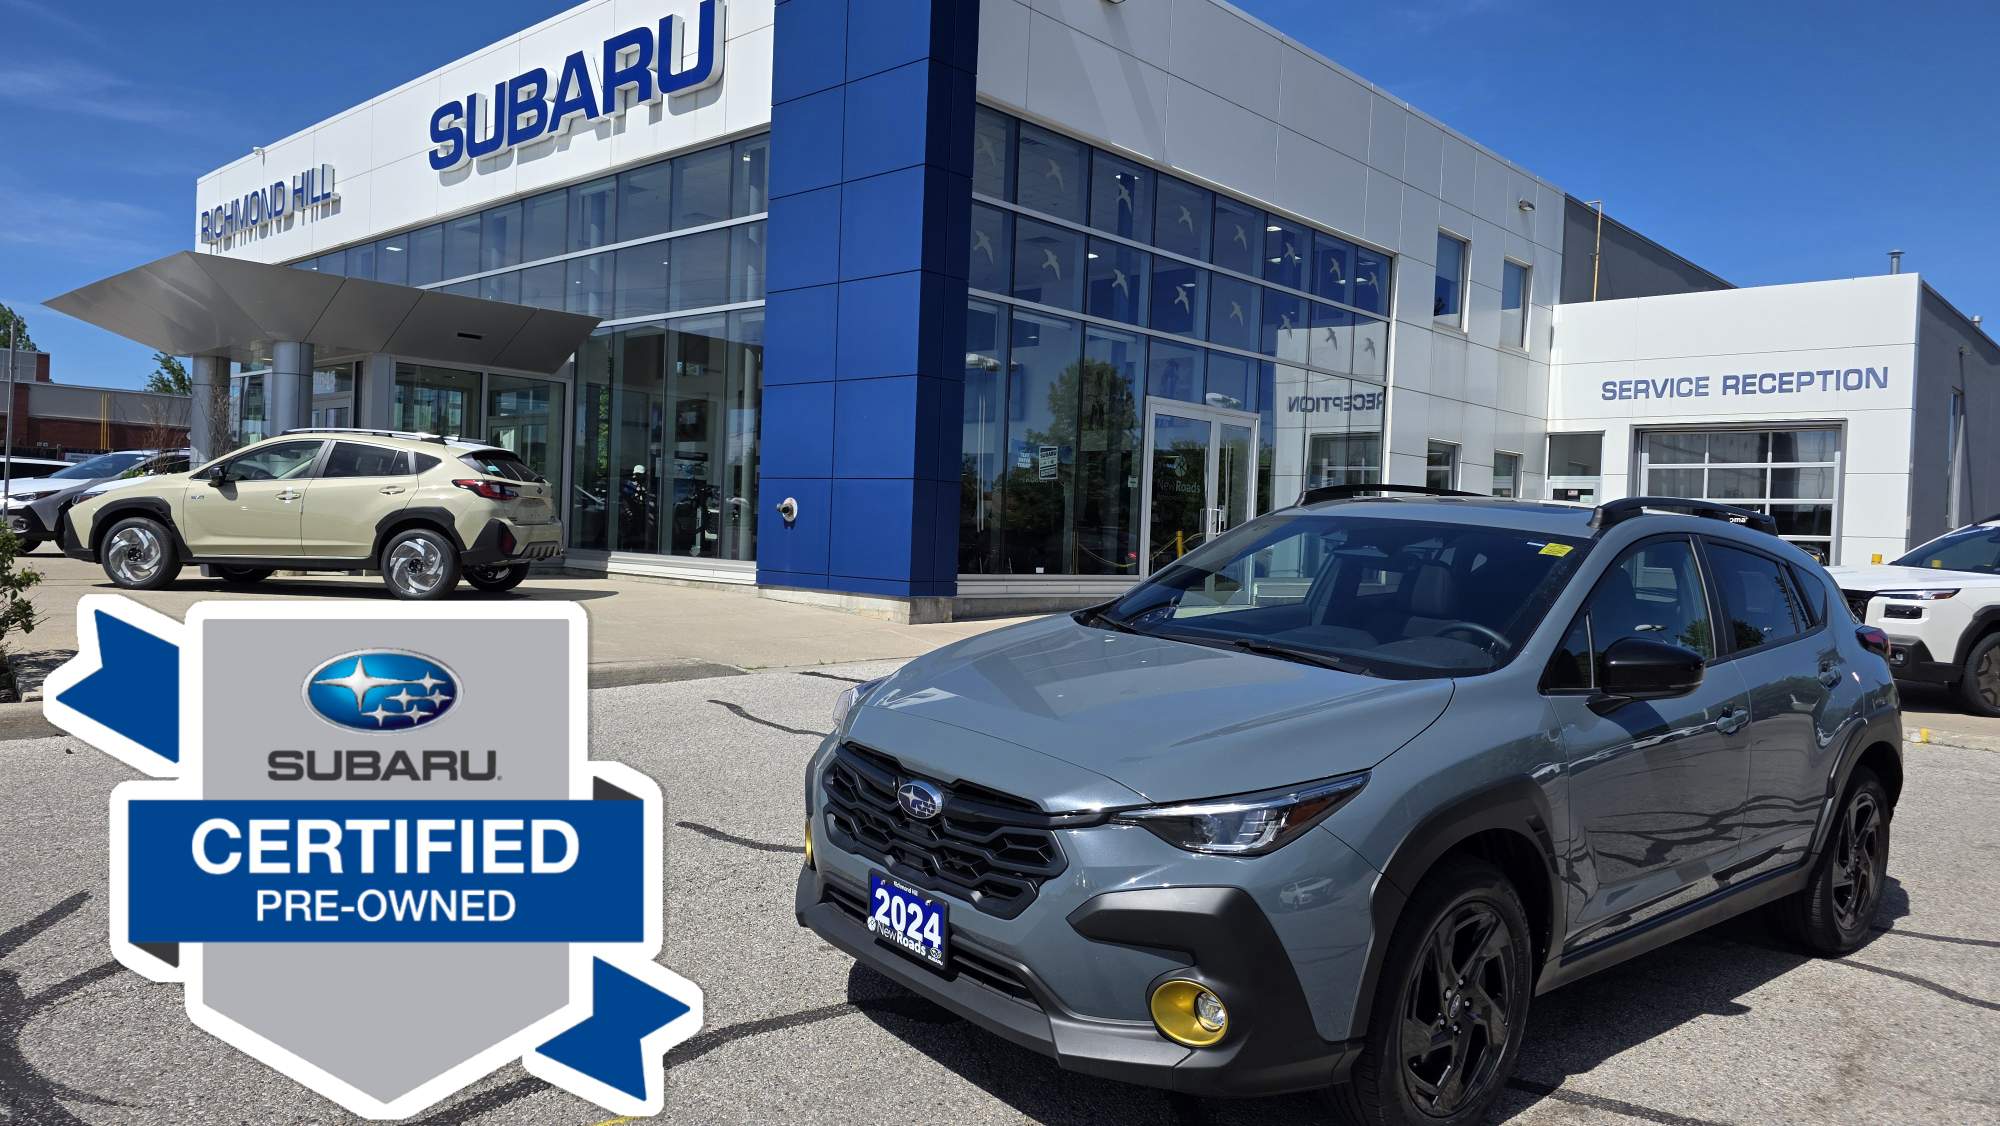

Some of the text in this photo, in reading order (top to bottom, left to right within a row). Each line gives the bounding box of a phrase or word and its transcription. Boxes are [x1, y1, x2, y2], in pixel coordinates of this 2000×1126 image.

[429, 0, 715, 171] SUBARU
[201, 164, 331, 241] RICHMOND HILL
[1601, 367, 1888, 400] SERVICE RECEPTION
[875, 887, 941, 948] 2024
[893, 880, 912, 894] Richmond
